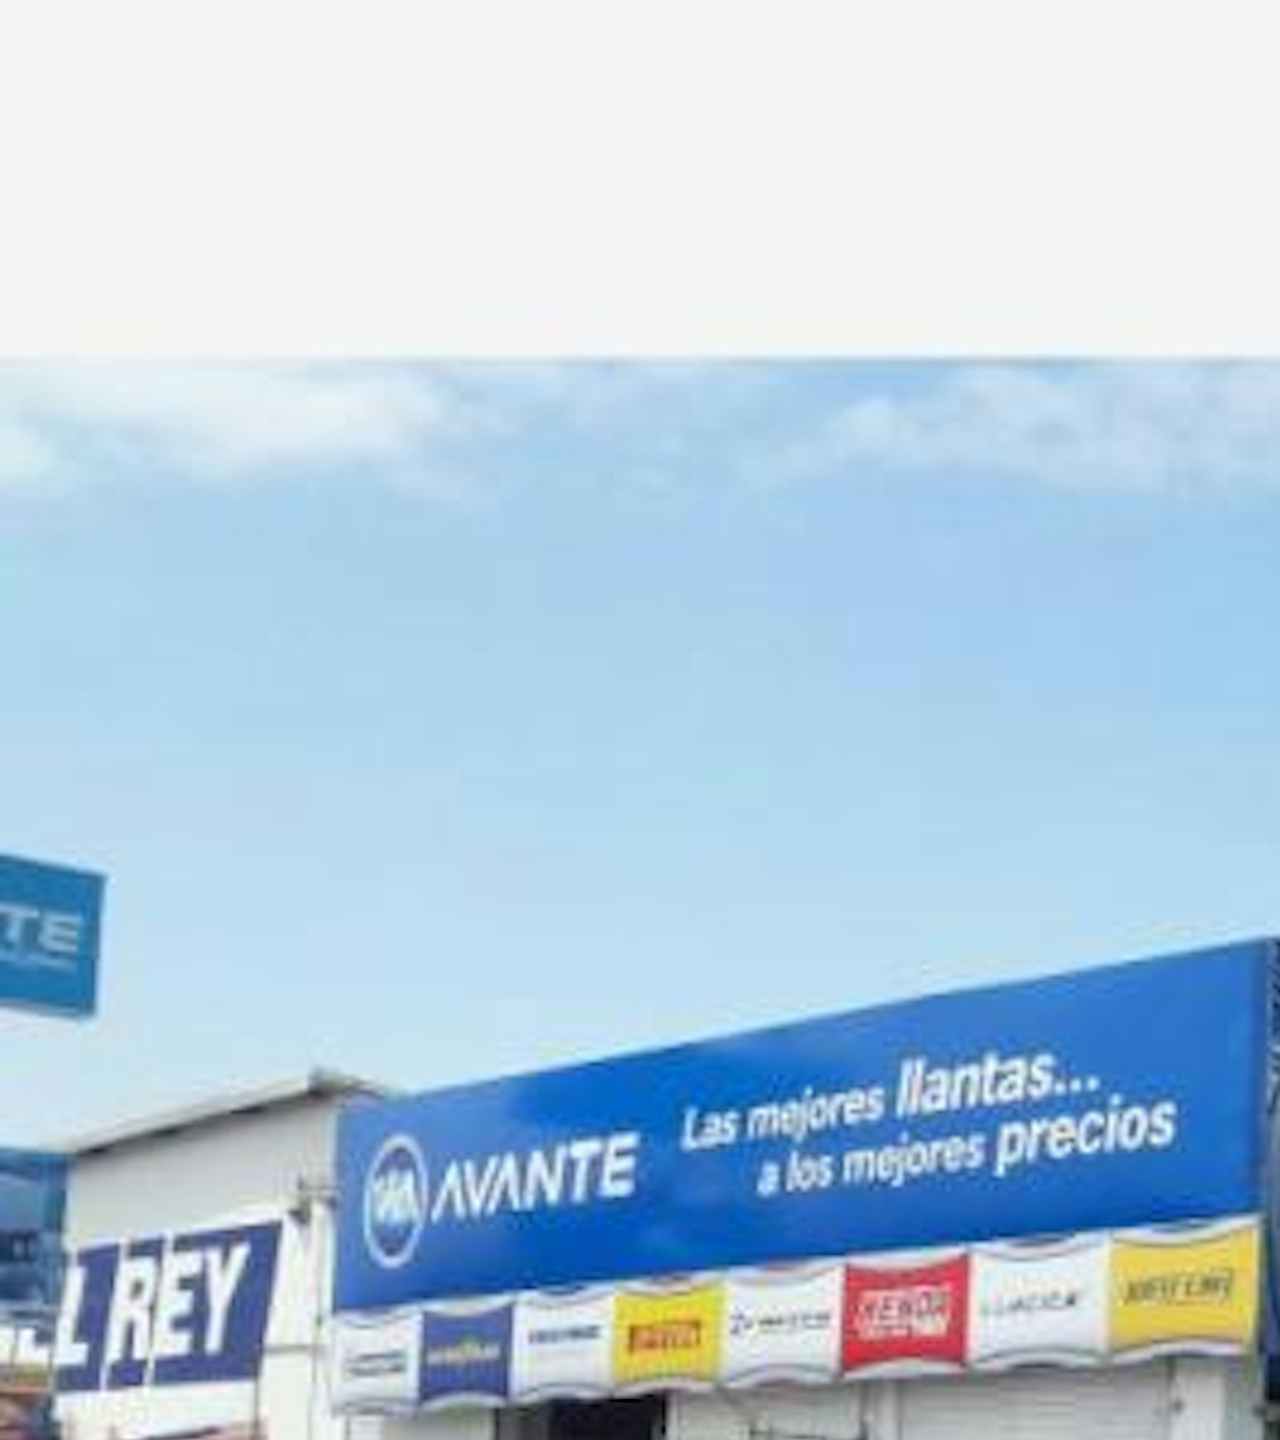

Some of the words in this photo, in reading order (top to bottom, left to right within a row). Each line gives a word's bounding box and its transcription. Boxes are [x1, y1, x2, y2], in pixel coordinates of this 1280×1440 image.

[680, 1105, 739, 1152] Las
[746, 1084, 885, 1143] mejores
[896, 1050, 1102, 1117] llantas...
[757, 1158, 780, 1197] a
[785, 1150, 833, 1193] los
[842, 1130, 985, 1188] mejores
[993, 1094, 1178, 1177] precios
[430, 1130, 641, 1225] AVANTE
[104, 1240, 251, 1363] REY
